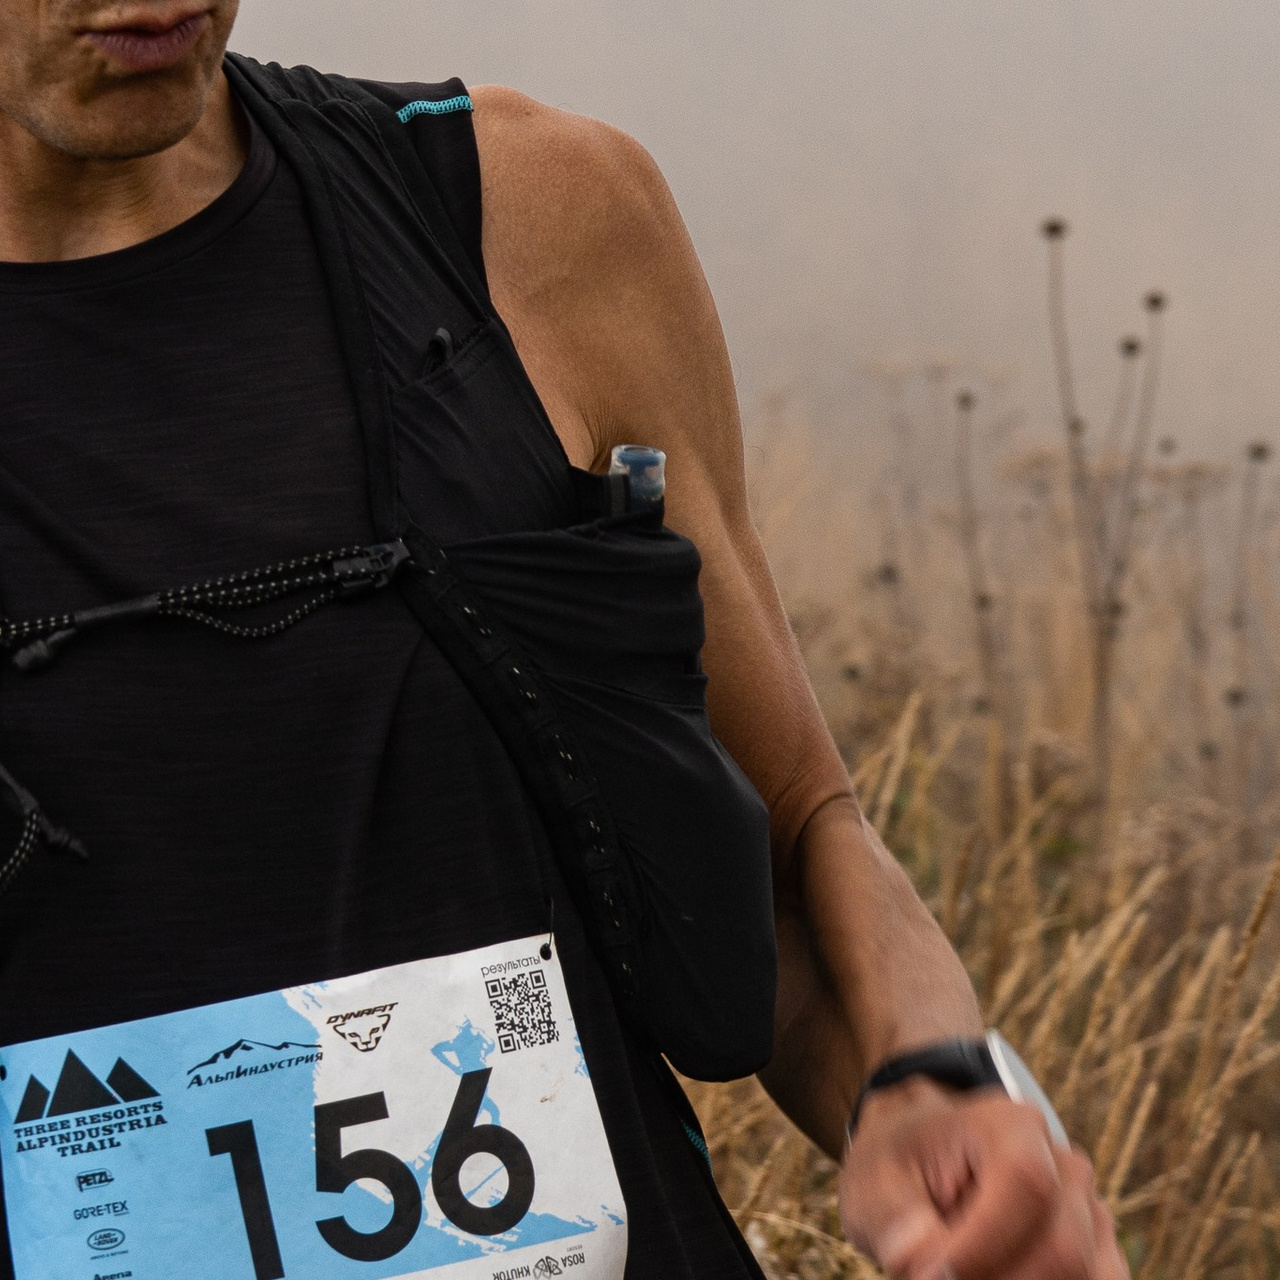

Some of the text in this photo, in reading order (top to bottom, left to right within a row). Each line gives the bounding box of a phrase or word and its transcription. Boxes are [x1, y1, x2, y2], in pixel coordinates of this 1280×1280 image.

[480, 955, 542, 978] результаты
[326, 1002, 399, 1025] DYNAFIT
[14, 1101, 163, 1138] THREE RESORTS
[16, 1114, 168, 1153] ALPINDUSTRIA
[57, 1137, 122, 1158] TRAIL
[77, 1170, 115, 1193] PETZL
[73, 1200, 129, 1221] GORE-TEX
[560, 1252, 586, 1268] ROSA
